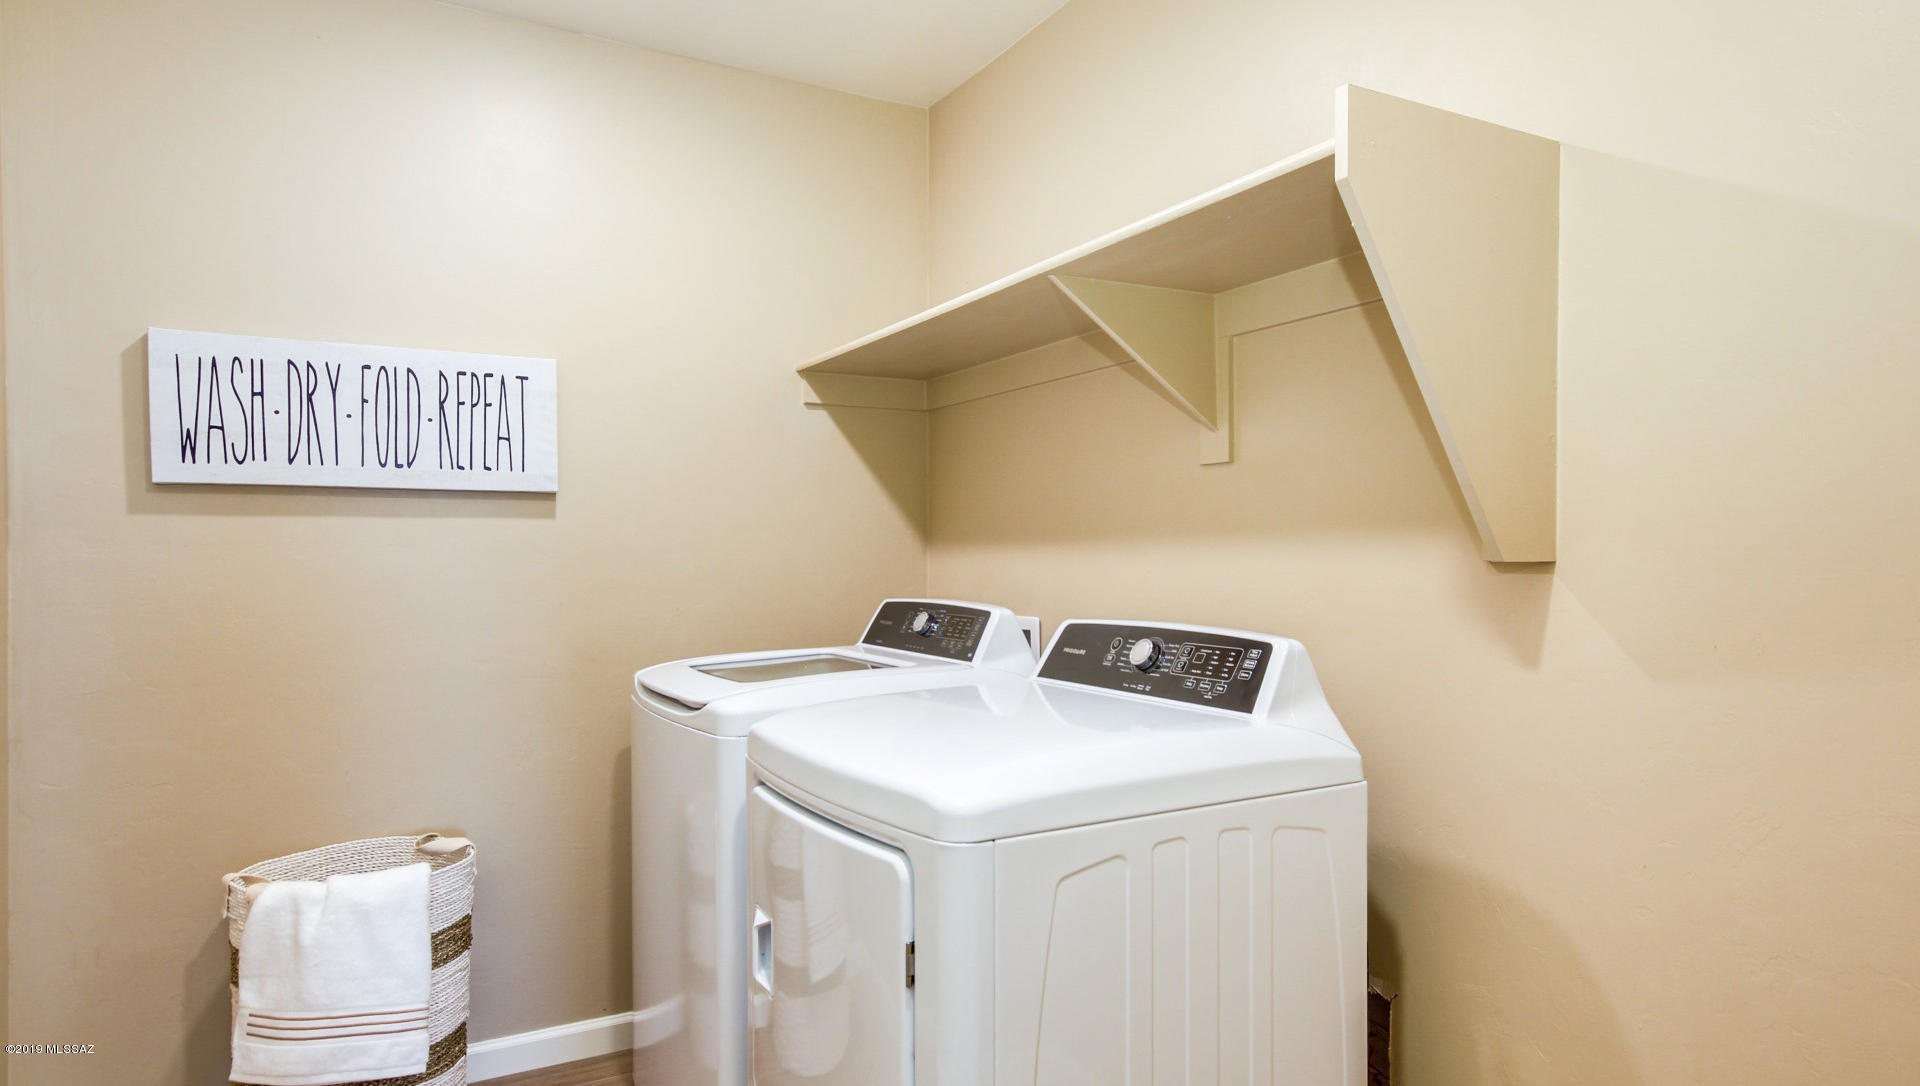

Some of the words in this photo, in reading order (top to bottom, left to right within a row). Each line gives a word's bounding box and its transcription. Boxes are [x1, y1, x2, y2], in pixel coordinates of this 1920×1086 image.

[175, 353, 268, 465] WASH
[287, 358, 341, 467] DRY
[360, 364, 421, 469] FOLD
[438, 369, 529, 473] REPEAT
